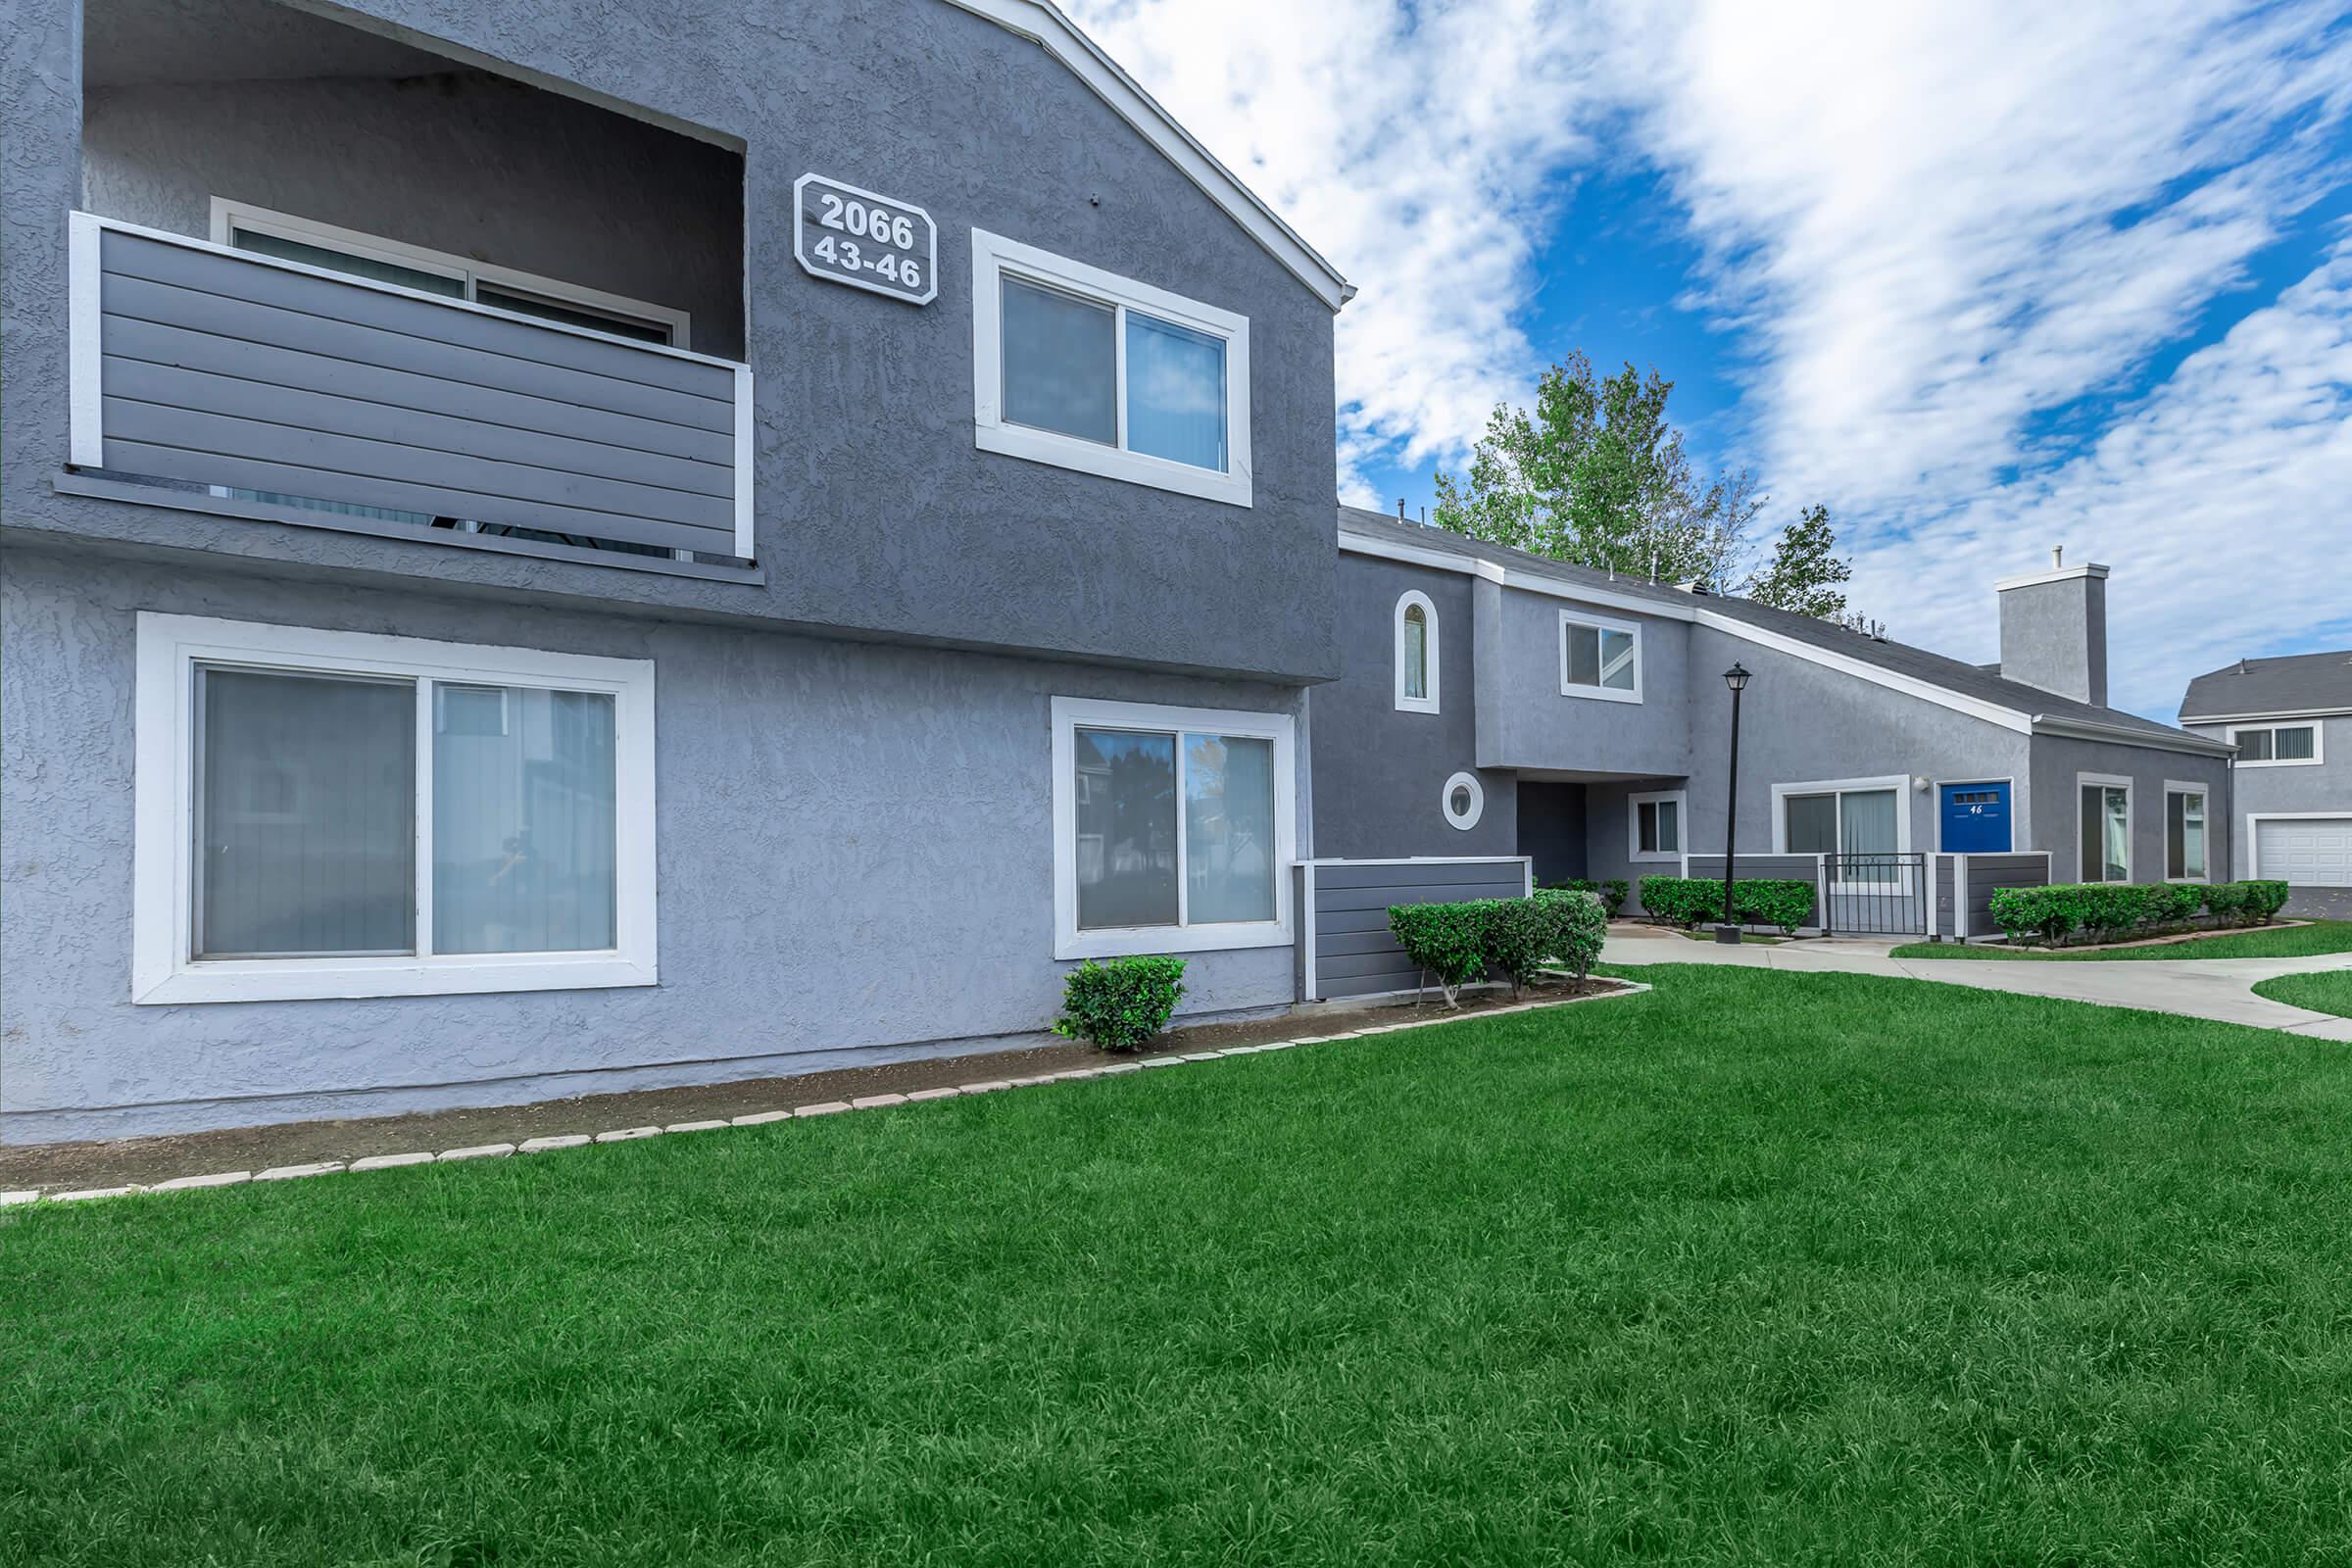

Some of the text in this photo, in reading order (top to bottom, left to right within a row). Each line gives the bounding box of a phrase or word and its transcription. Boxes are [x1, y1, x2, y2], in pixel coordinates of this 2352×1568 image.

[821, 194, 913, 250] 2066
[814, 236, 920, 287] 43-46
[1970, 805, 1983, 814] 46
